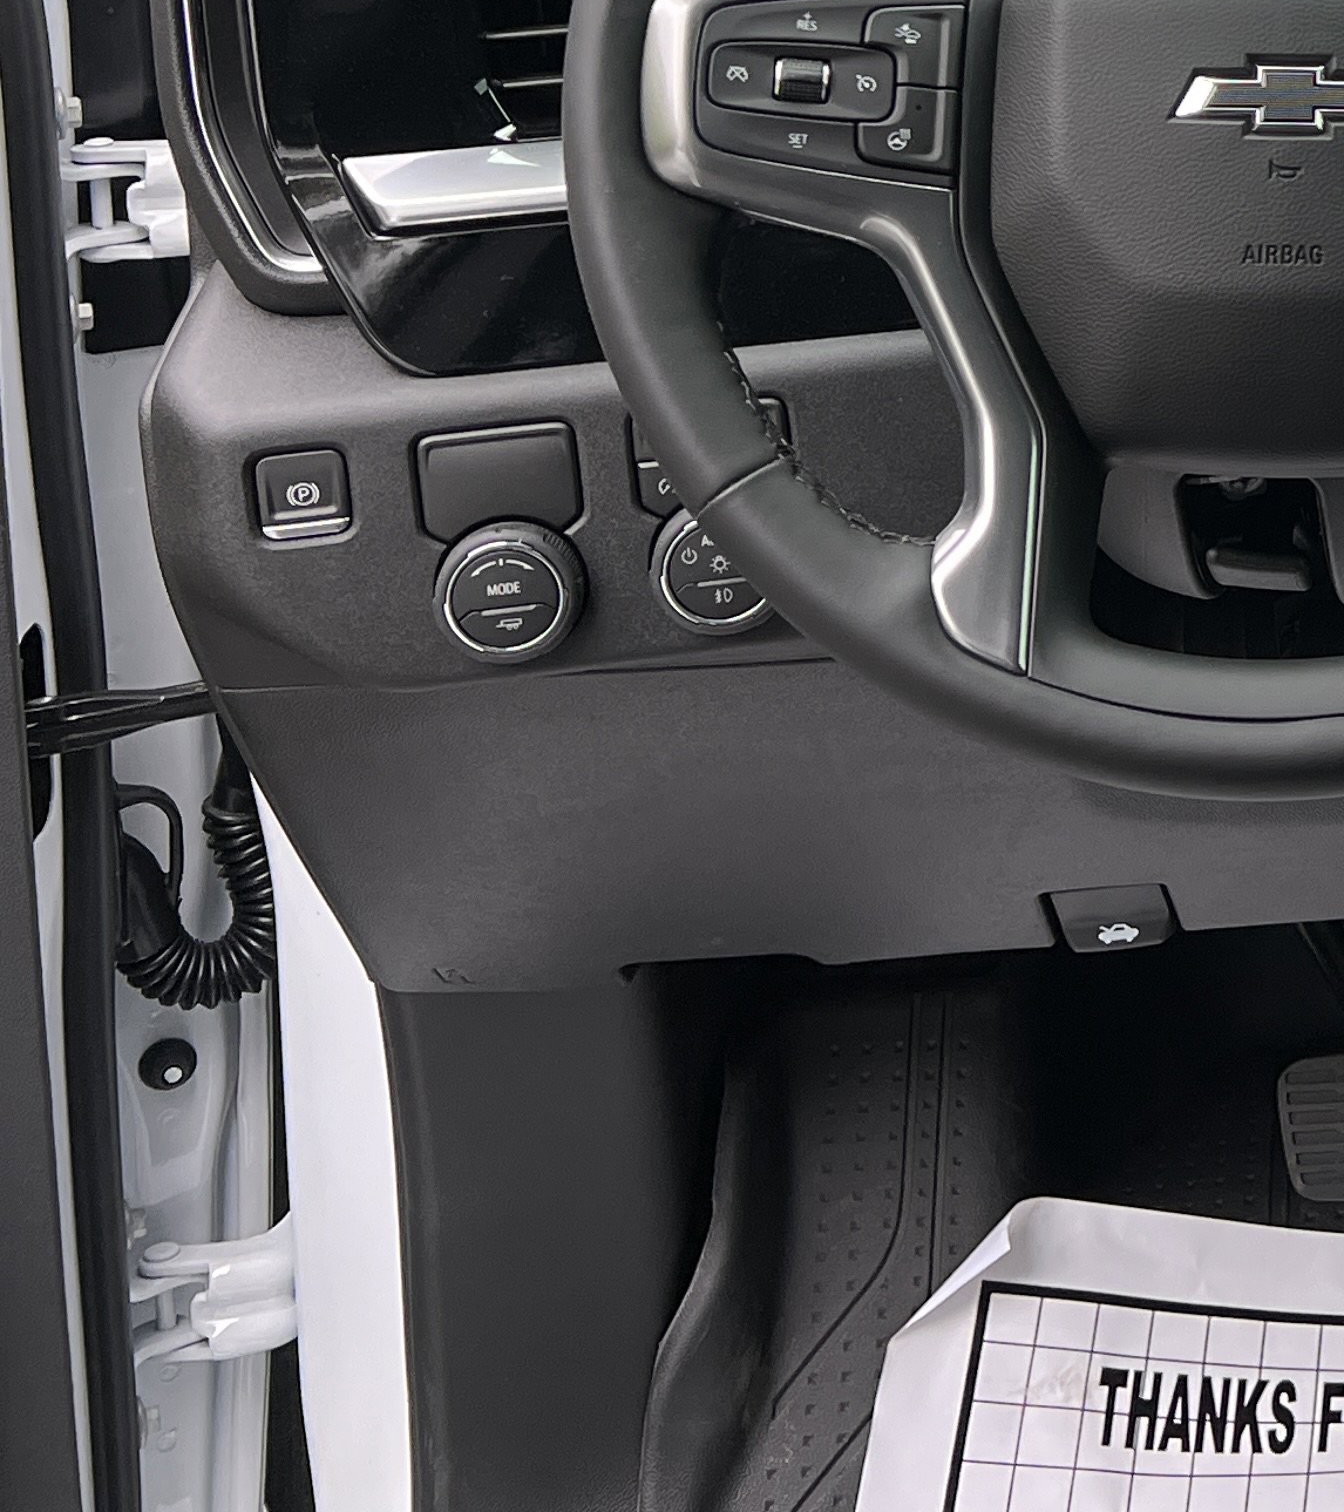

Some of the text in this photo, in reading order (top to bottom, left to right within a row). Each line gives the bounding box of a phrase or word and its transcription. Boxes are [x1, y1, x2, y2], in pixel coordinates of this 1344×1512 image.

[796, 19, 818, 31] RES
[788, 133, 808, 145] SET
[1240, 244, 1324, 265] AIRBAG
[487, 581, 521, 597] MODE
[1100, 1366, 1297, 1454] THANKS
